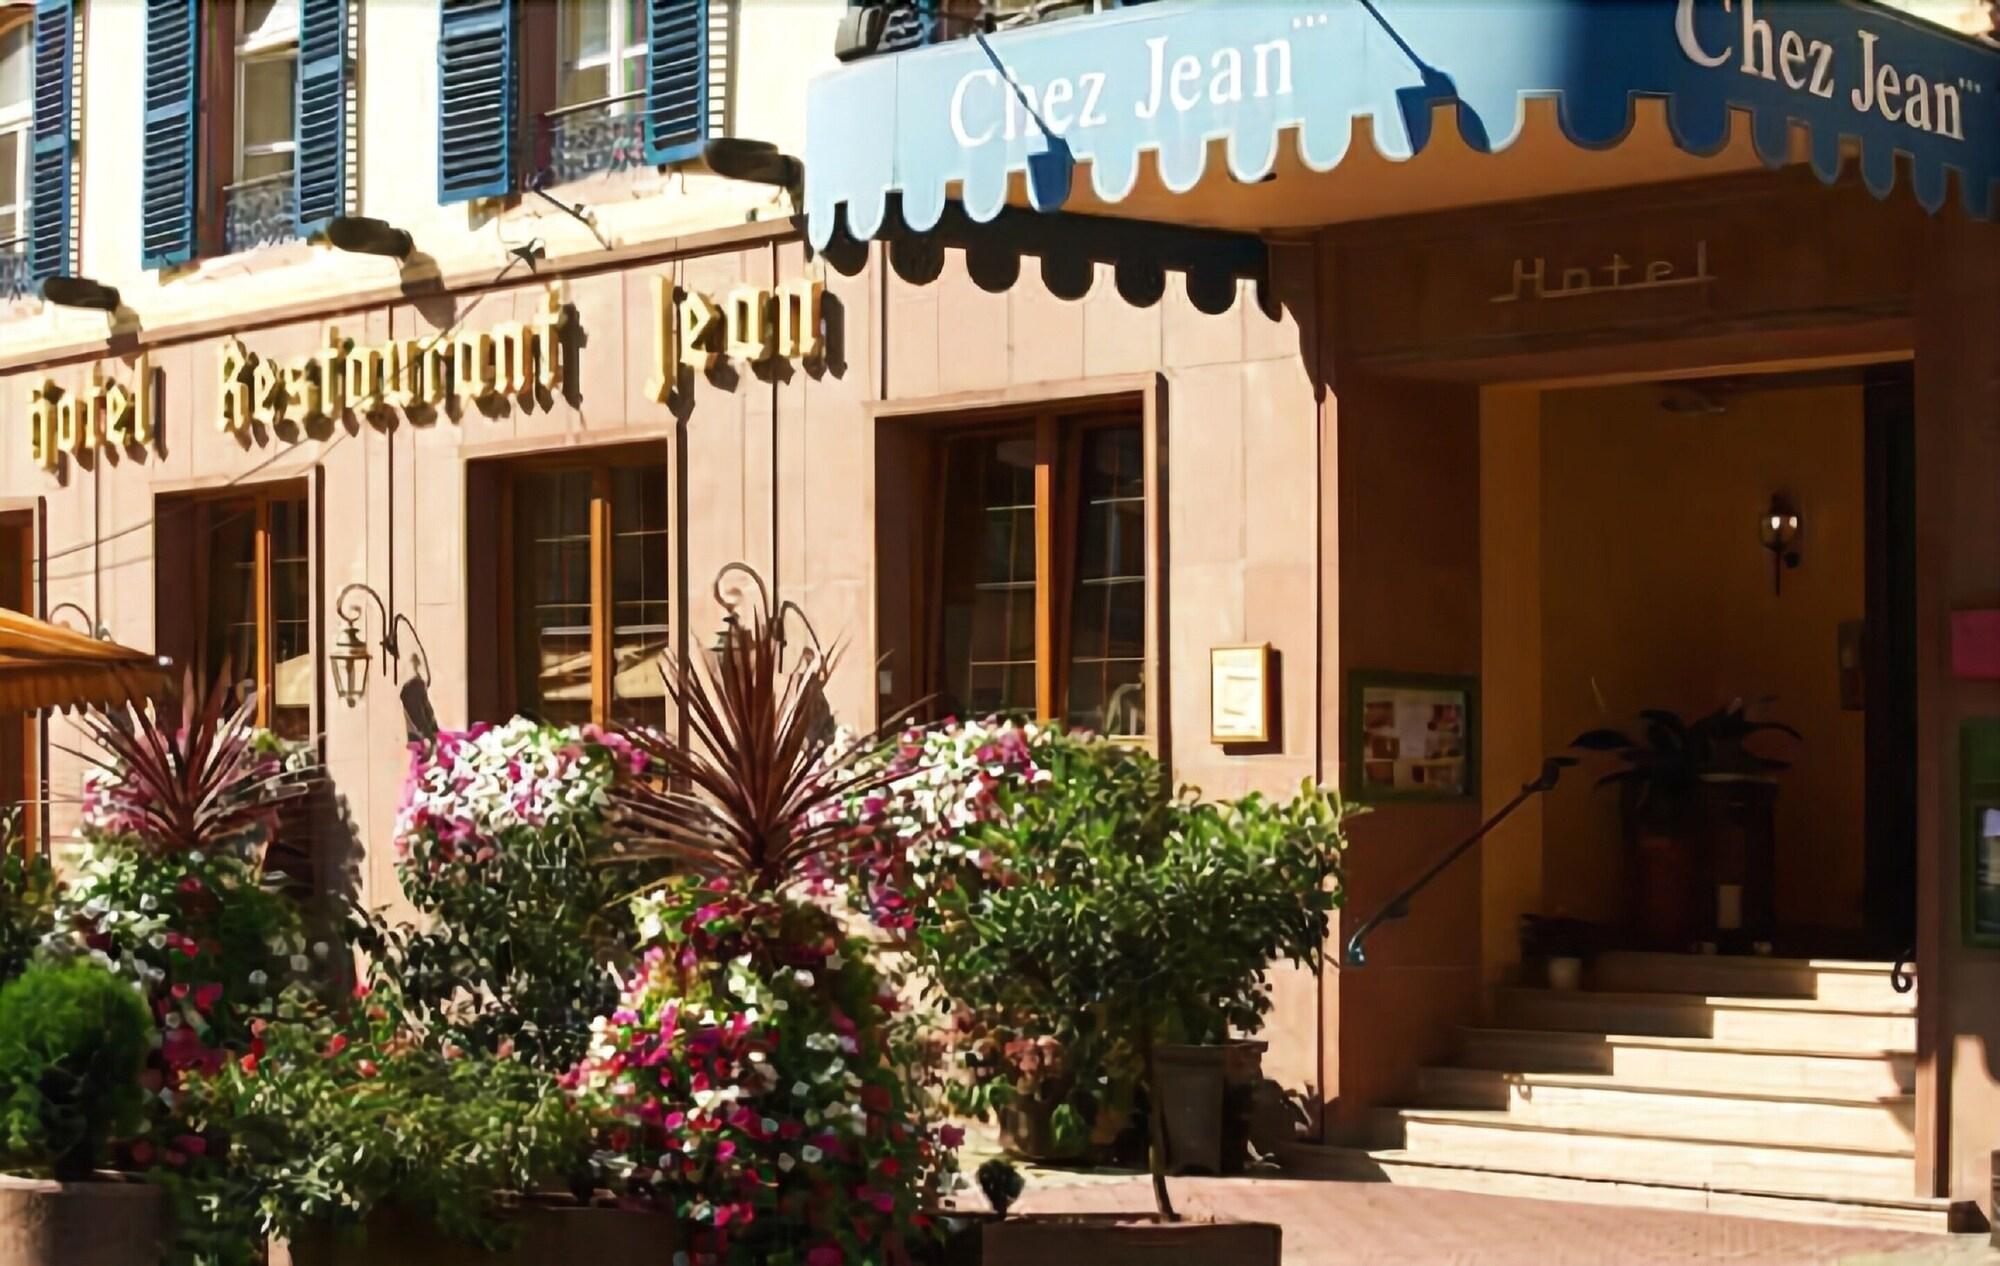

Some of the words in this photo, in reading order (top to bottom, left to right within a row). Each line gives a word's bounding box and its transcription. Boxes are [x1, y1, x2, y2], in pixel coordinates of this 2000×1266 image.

[1674, 0, 1835, 99] Chez
[949, 66, 1106, 148] Chez
[1490, 239, 1717, 302] Hotel
[217, 282, 566, 433] Restaurant
[644, 274, 823, 404] Jean
